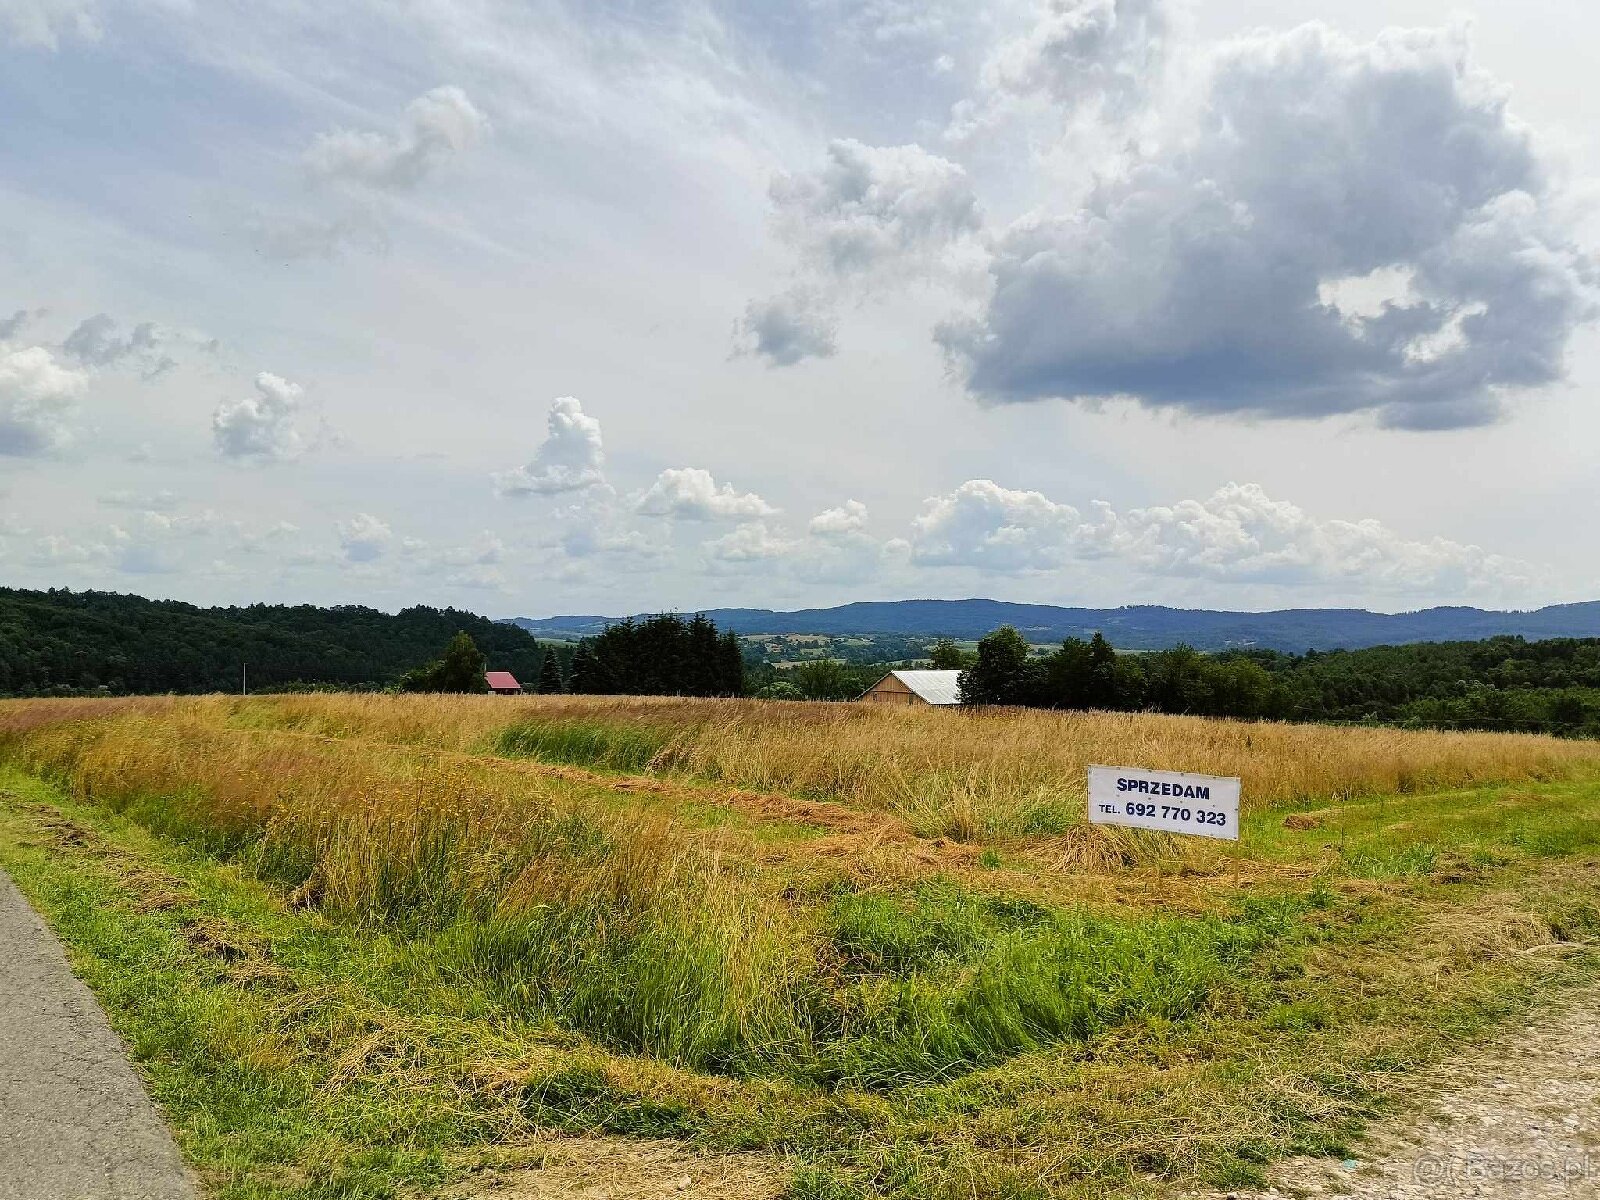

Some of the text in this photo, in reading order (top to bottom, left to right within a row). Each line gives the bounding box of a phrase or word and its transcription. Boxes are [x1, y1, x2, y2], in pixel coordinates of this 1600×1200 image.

[1116, 777, 1210, 801] SPRZEDAM
[1098, 801, 1226, 827] TEL. 692 770 323
